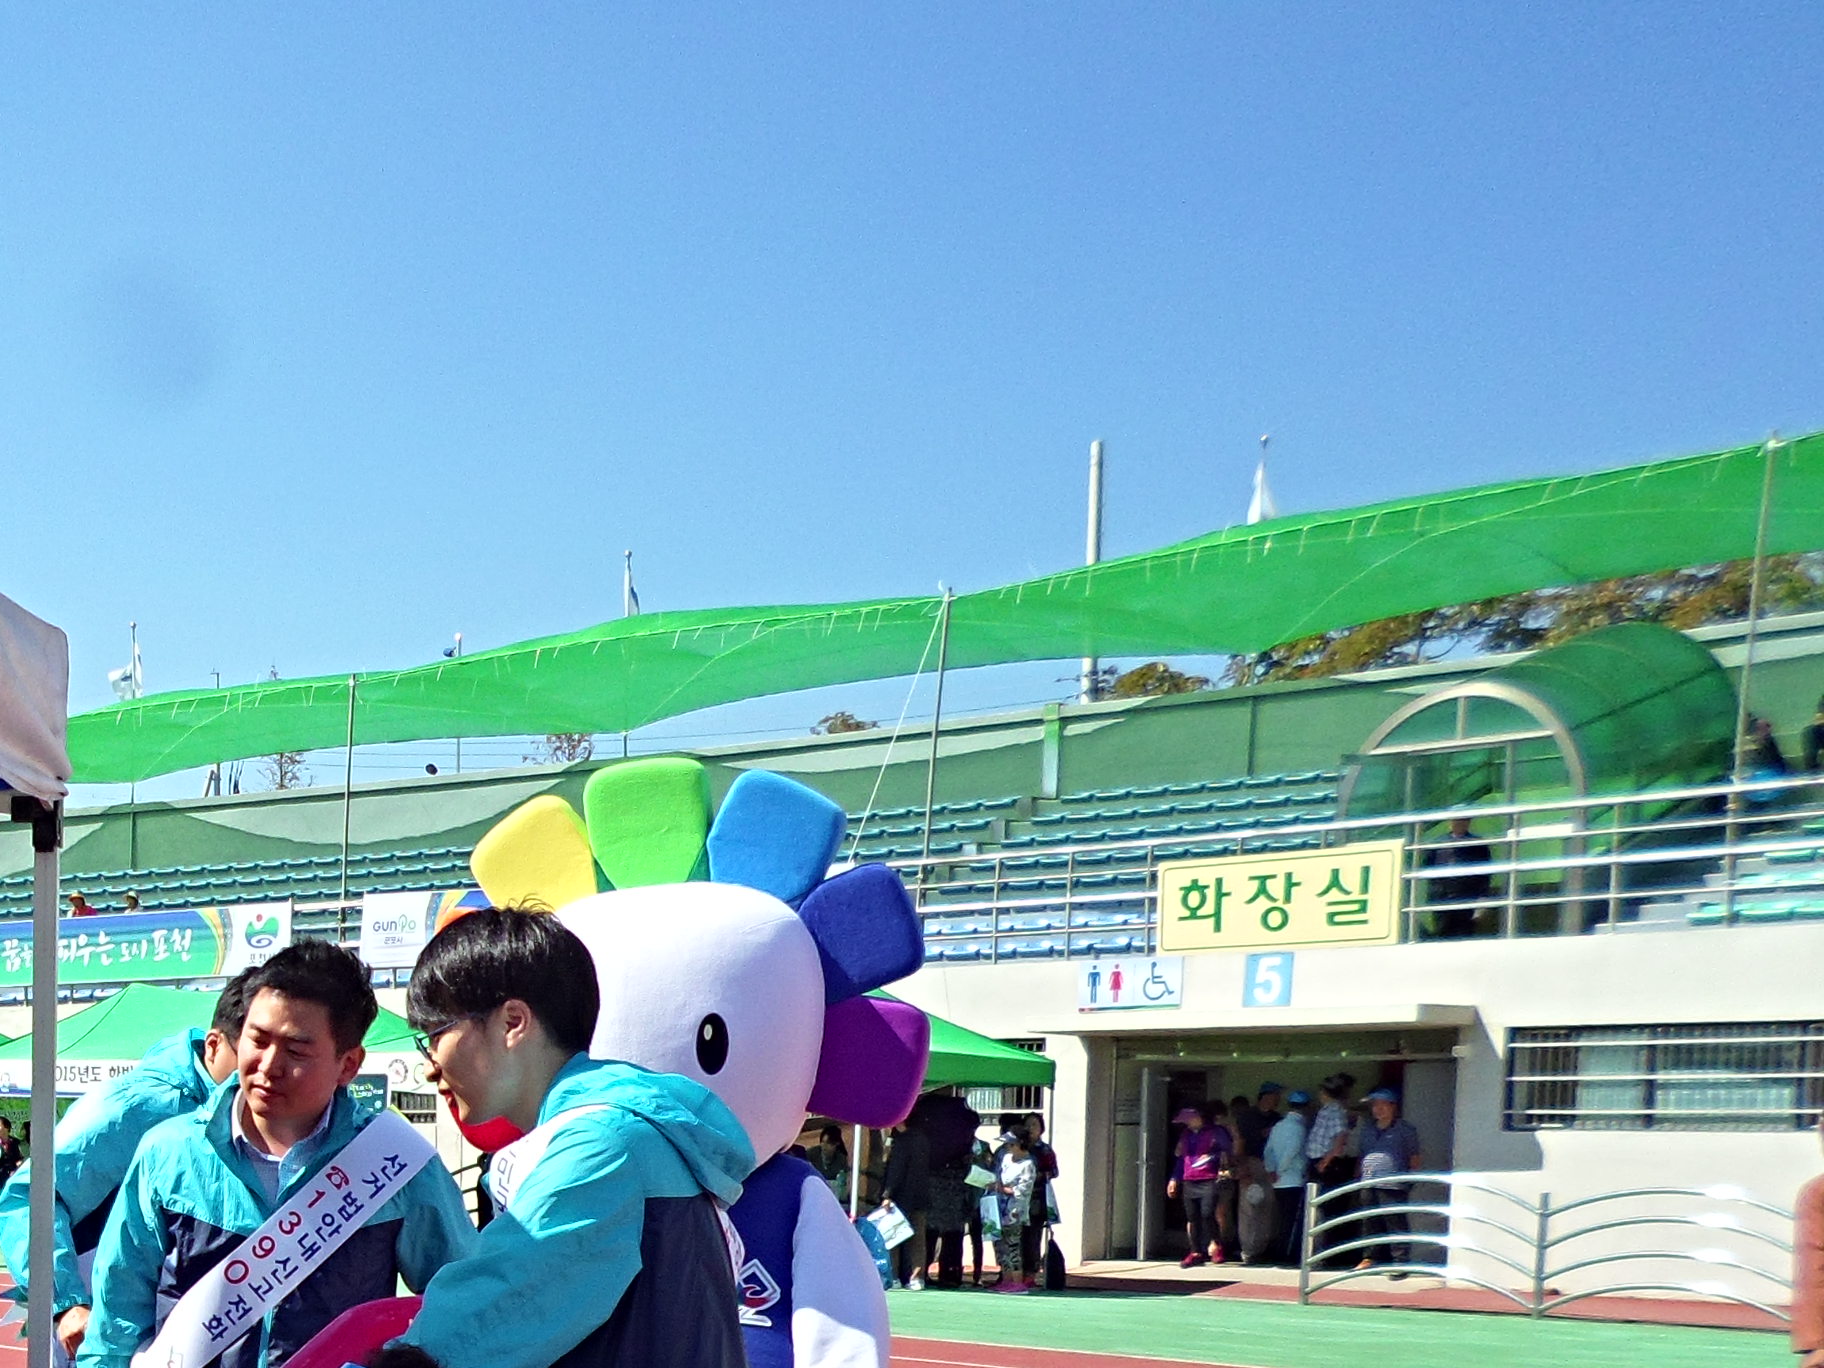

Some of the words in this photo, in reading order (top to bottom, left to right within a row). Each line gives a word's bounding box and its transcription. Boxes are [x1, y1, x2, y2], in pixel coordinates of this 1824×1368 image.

[1176, 865, 1374, 933] 화장실
[152, 927, 193, 963] 포천
[1253, 956, 1283, 1004] 5
[56, 1065, 102, 1083] 015년도
[224, 1189, 326, 1285] 1390
